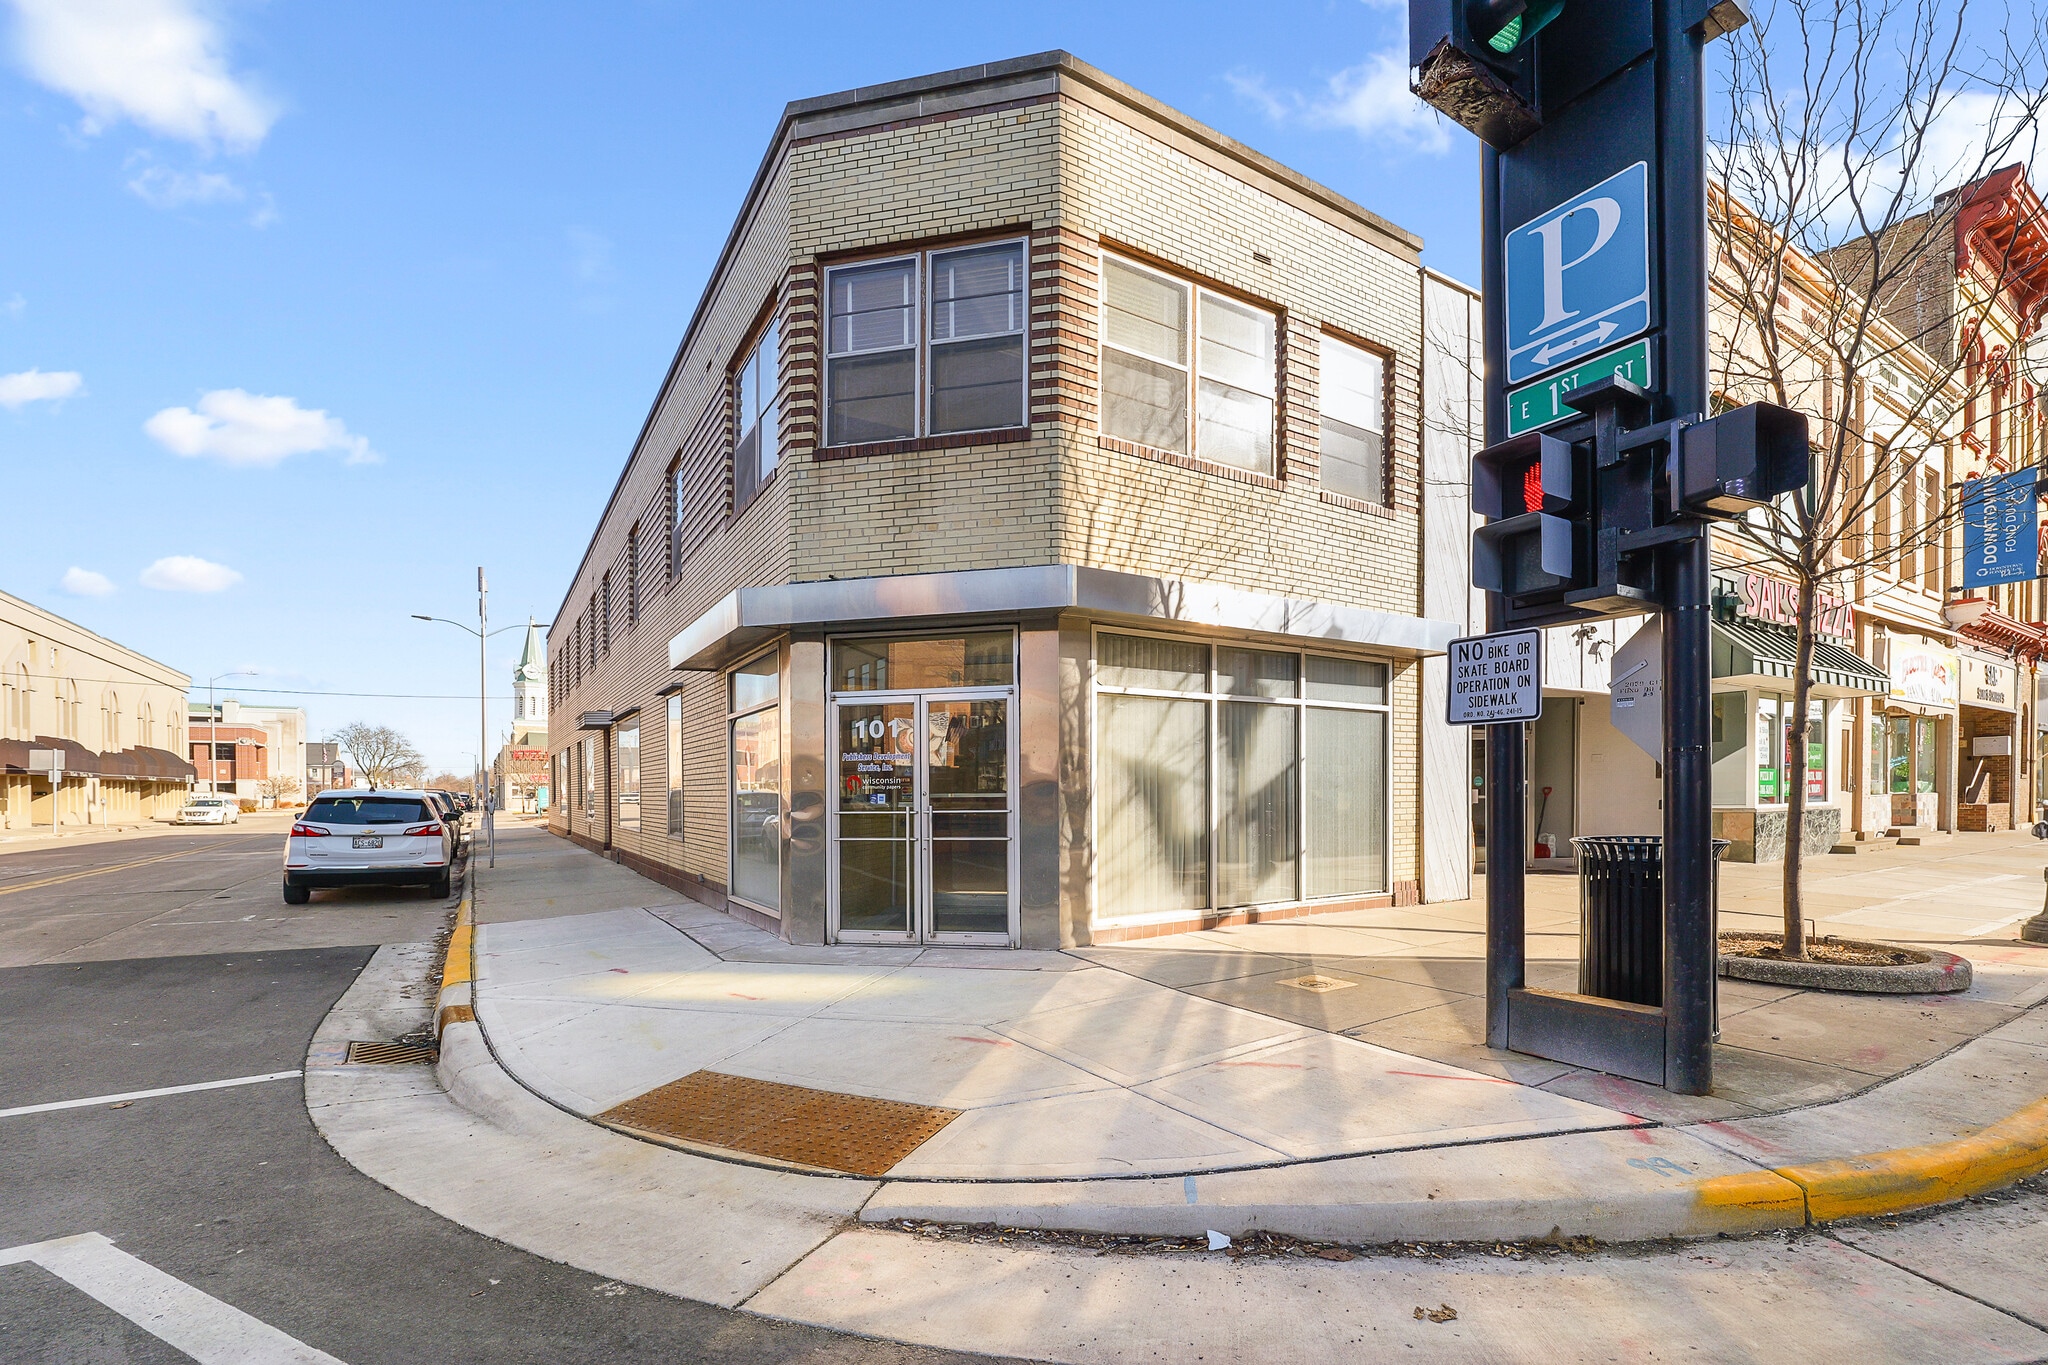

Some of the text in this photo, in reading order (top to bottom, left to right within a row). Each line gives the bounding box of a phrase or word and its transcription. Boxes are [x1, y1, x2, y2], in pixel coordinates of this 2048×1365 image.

[1527, 197, 1622, 336] P
[1521, 360, 1634, 420] E 1ST ST
[2005, 524, 2017, 552] FOND
[1816, 593, 1855, 639] IZZA
[1459, 641, 1530, 663] NO BIKE OR
[1458, 658, 1529, 679] SKATE BOARD
[1456, 674, 1531, 694] OPERATION ON
[1468, 691, 1518, 708] SIDEWALK
[855, 720, 898, 739] 101
[842, 752, 912, 762] Publishers Development
[857, 762, 894, 772] Service, Inc.
[862, 777, 901, 785] wisconsin
